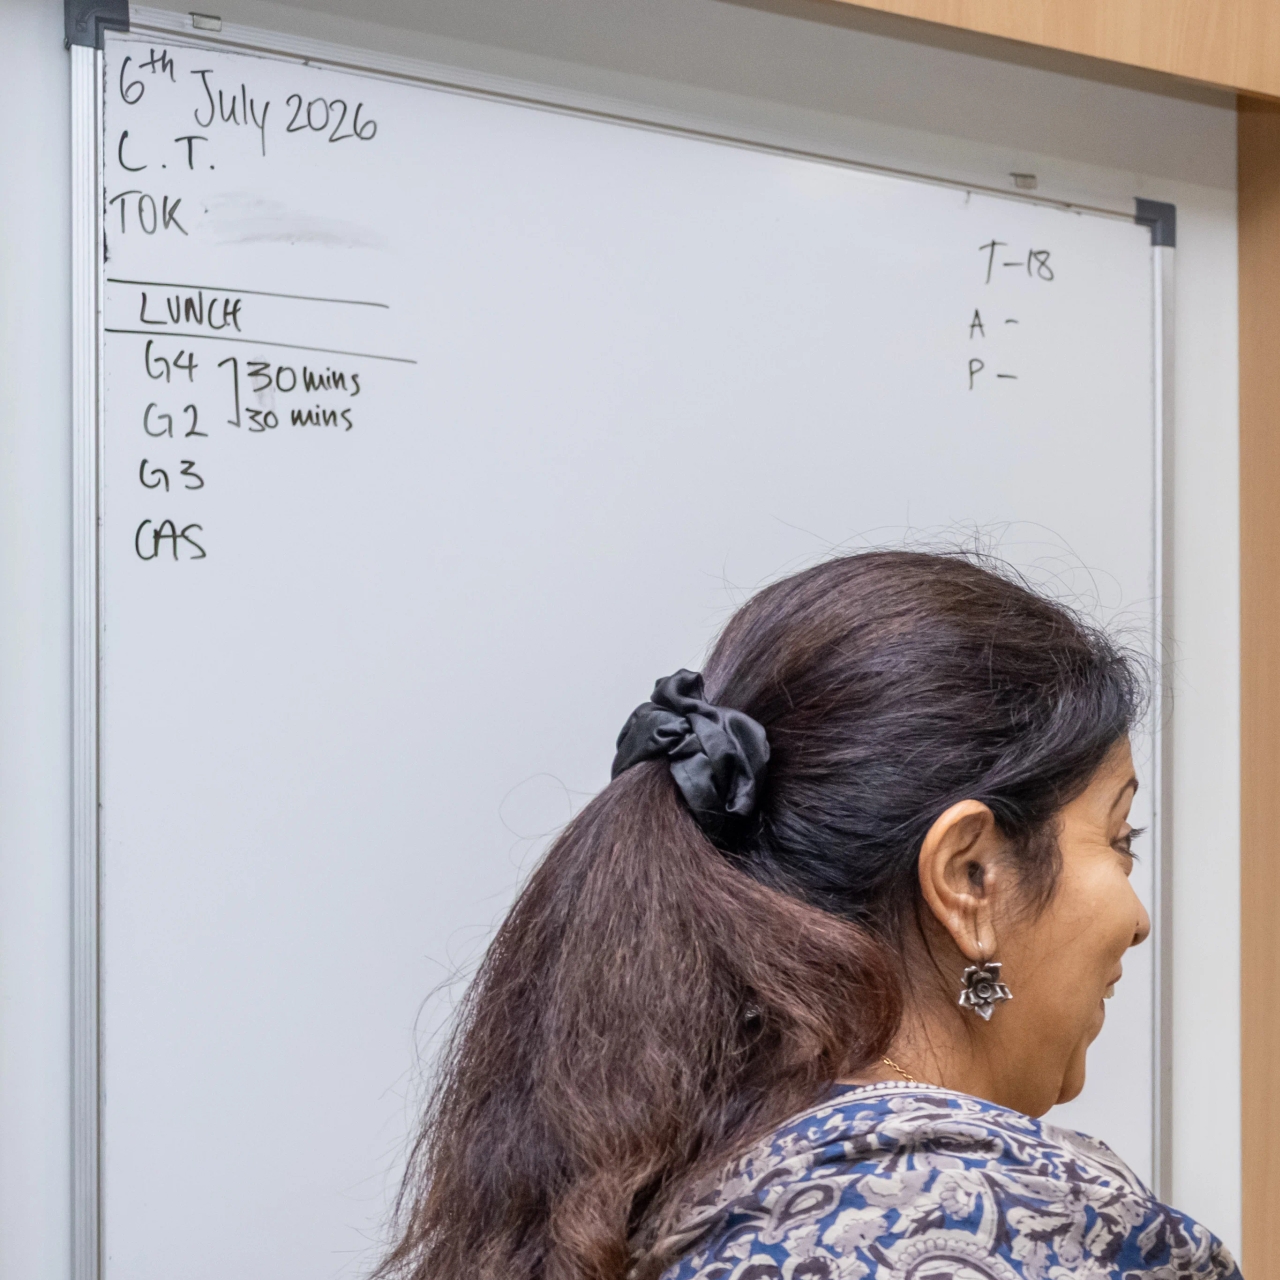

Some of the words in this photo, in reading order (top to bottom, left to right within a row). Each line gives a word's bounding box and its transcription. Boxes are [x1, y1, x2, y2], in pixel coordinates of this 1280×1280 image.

[119, 48, 176, 105] 6th
[191, 68, 270, 157] July
[286, 94, 377, 143] 2026
[109, 190, 188, 236] TOK
[140, 291, 241, 332] LUNCH
[145, 340, 198, 383] G4
[303, 366, 360, 397] mins
[245, 407, 278, 432] 30
[291, 404, 353, 432] mins
[135, 519, 206, 561] CAS
